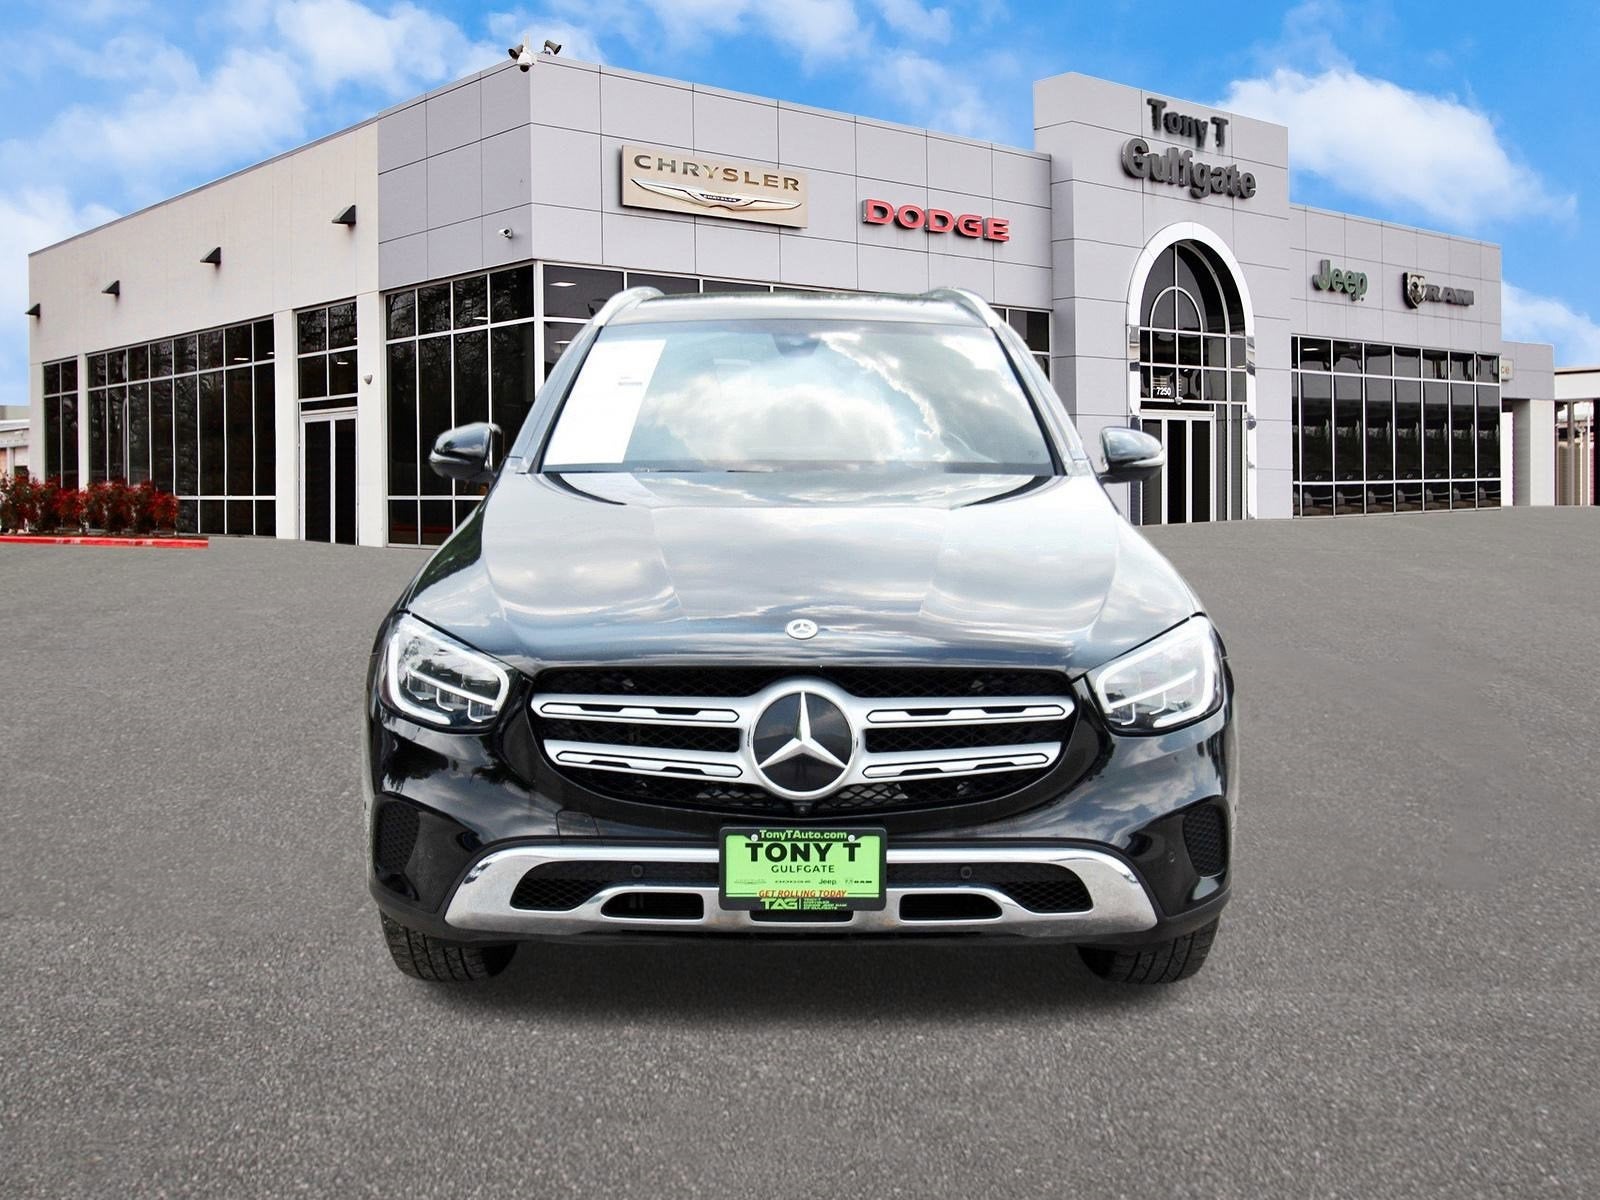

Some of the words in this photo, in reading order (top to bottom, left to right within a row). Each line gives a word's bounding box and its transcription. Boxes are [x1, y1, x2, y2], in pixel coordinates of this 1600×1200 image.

[1146, 98, 1208, 148] Tony
[1210, 116, 1229, 148] T
[634, 154, 800, 192] CHRYSLER
[1120, 138, 1257, 199] Gulfgate
[862, 199, 1010, 242] DODGE
[1312, 259, 1368, 301] Jeep
[1424, 284, 1475, 306] RAM
[759, 829, 847, 841] TonyTAuto.com
[745, 842, 833, 863] TONY
[842, 842, 862, 863] T
[771, 864, 835, 873] GULFGATE
[758, 889, 776, 898] GET
[777, 889, 817, 898] ROLLING
[818, 889, 847, 898] TODAY
